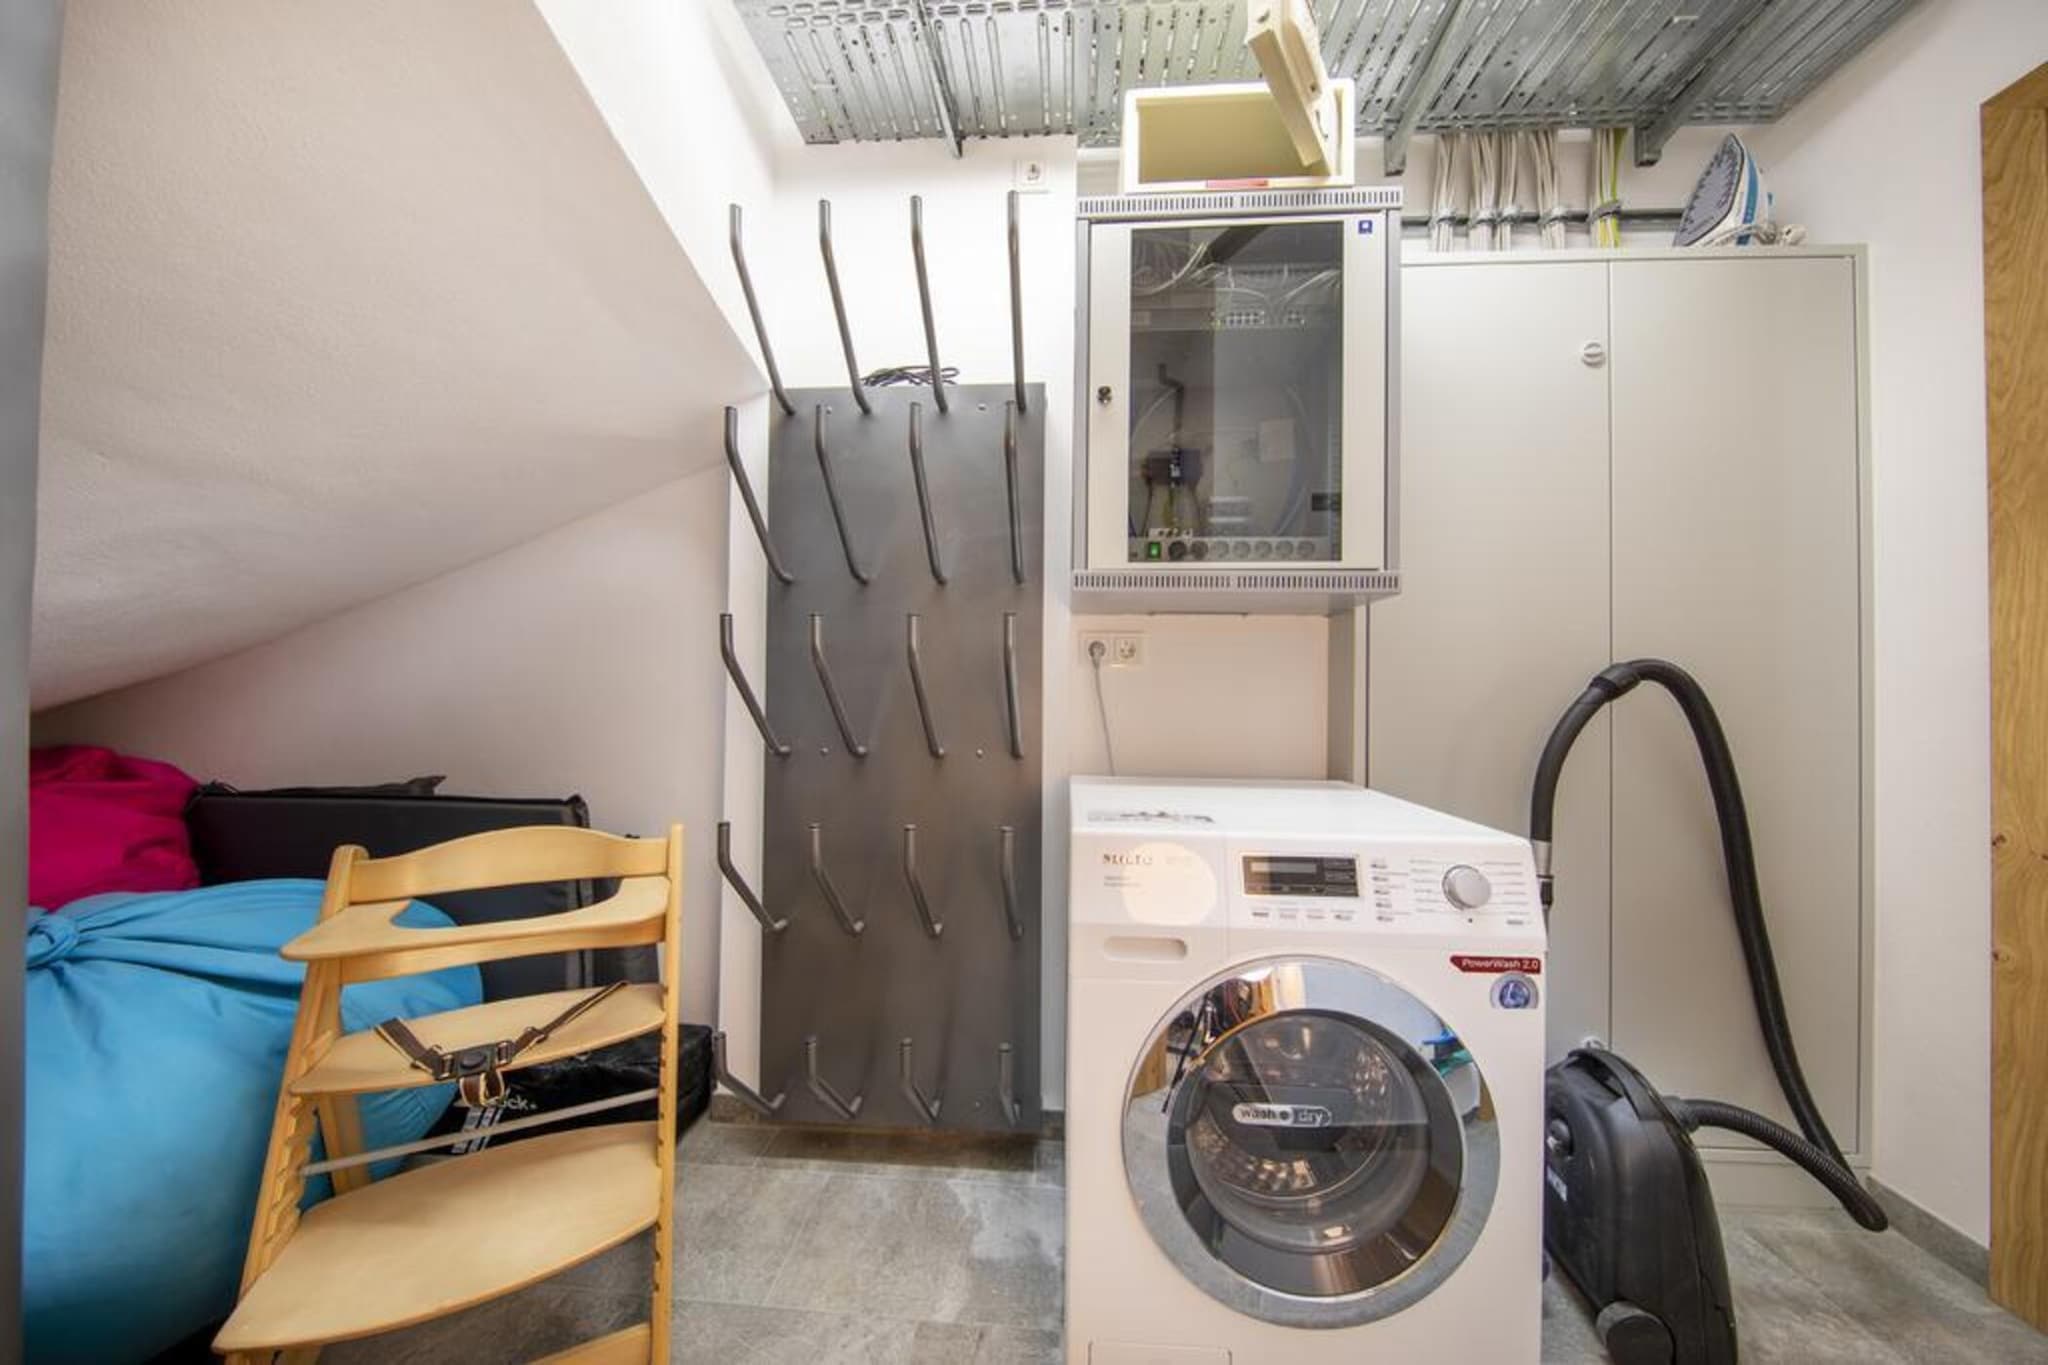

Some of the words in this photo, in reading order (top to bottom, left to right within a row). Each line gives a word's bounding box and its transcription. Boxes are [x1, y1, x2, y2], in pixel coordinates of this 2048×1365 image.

[1461, 958, 1520, 969] PowerWash
[1522, 960, 1539, 970] 2.0
[1241, 1106, 1277, 1121] wash
[1299, 1109, 1323, 1126] dry
